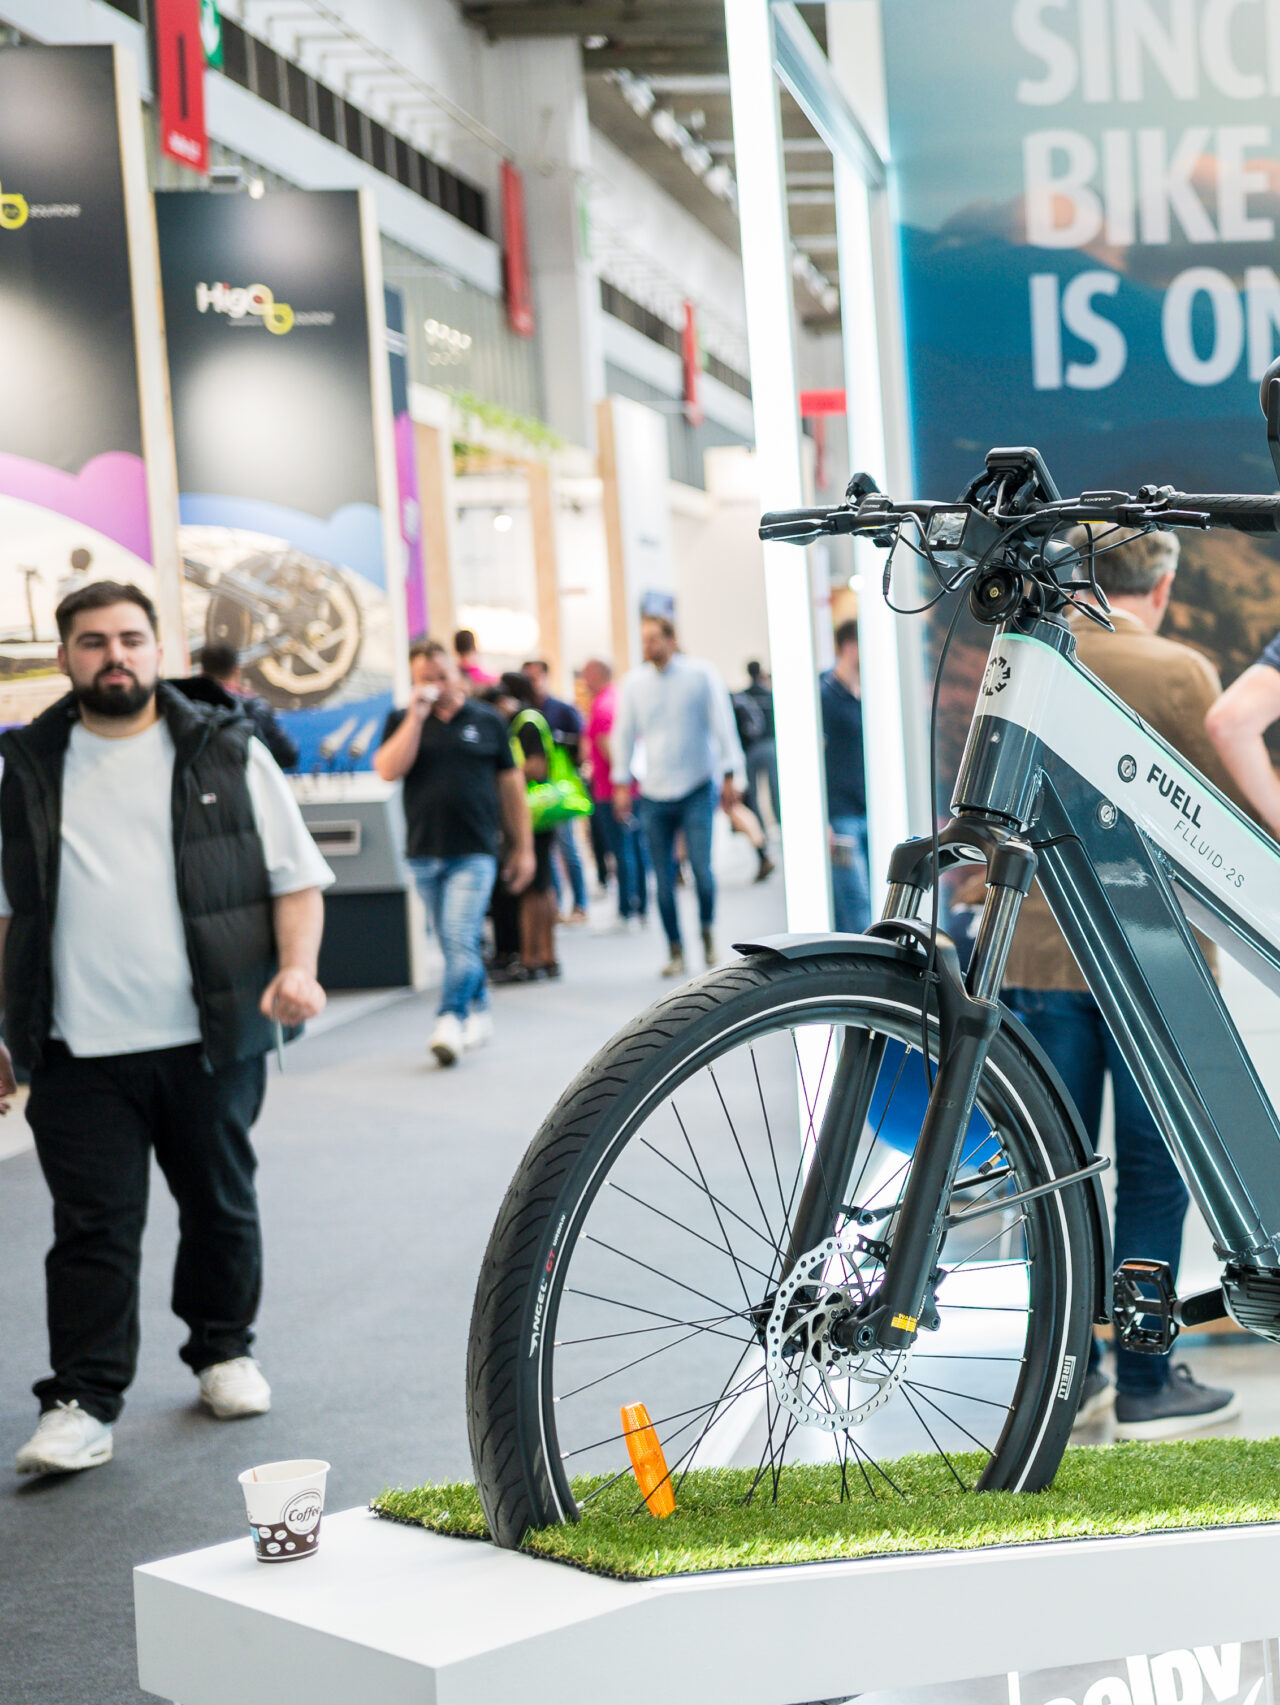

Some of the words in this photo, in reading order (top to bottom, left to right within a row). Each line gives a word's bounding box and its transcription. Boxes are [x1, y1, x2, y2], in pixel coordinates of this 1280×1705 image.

[1023, 125, 1275, 249] BIKE
[1029, 271, 1128, 391] IS
[1146, 763, 1202, 829] FUELL
[1173, 820, 1245, 888] FLLUID-2S
[545, 1248, 556, 1273] GT
